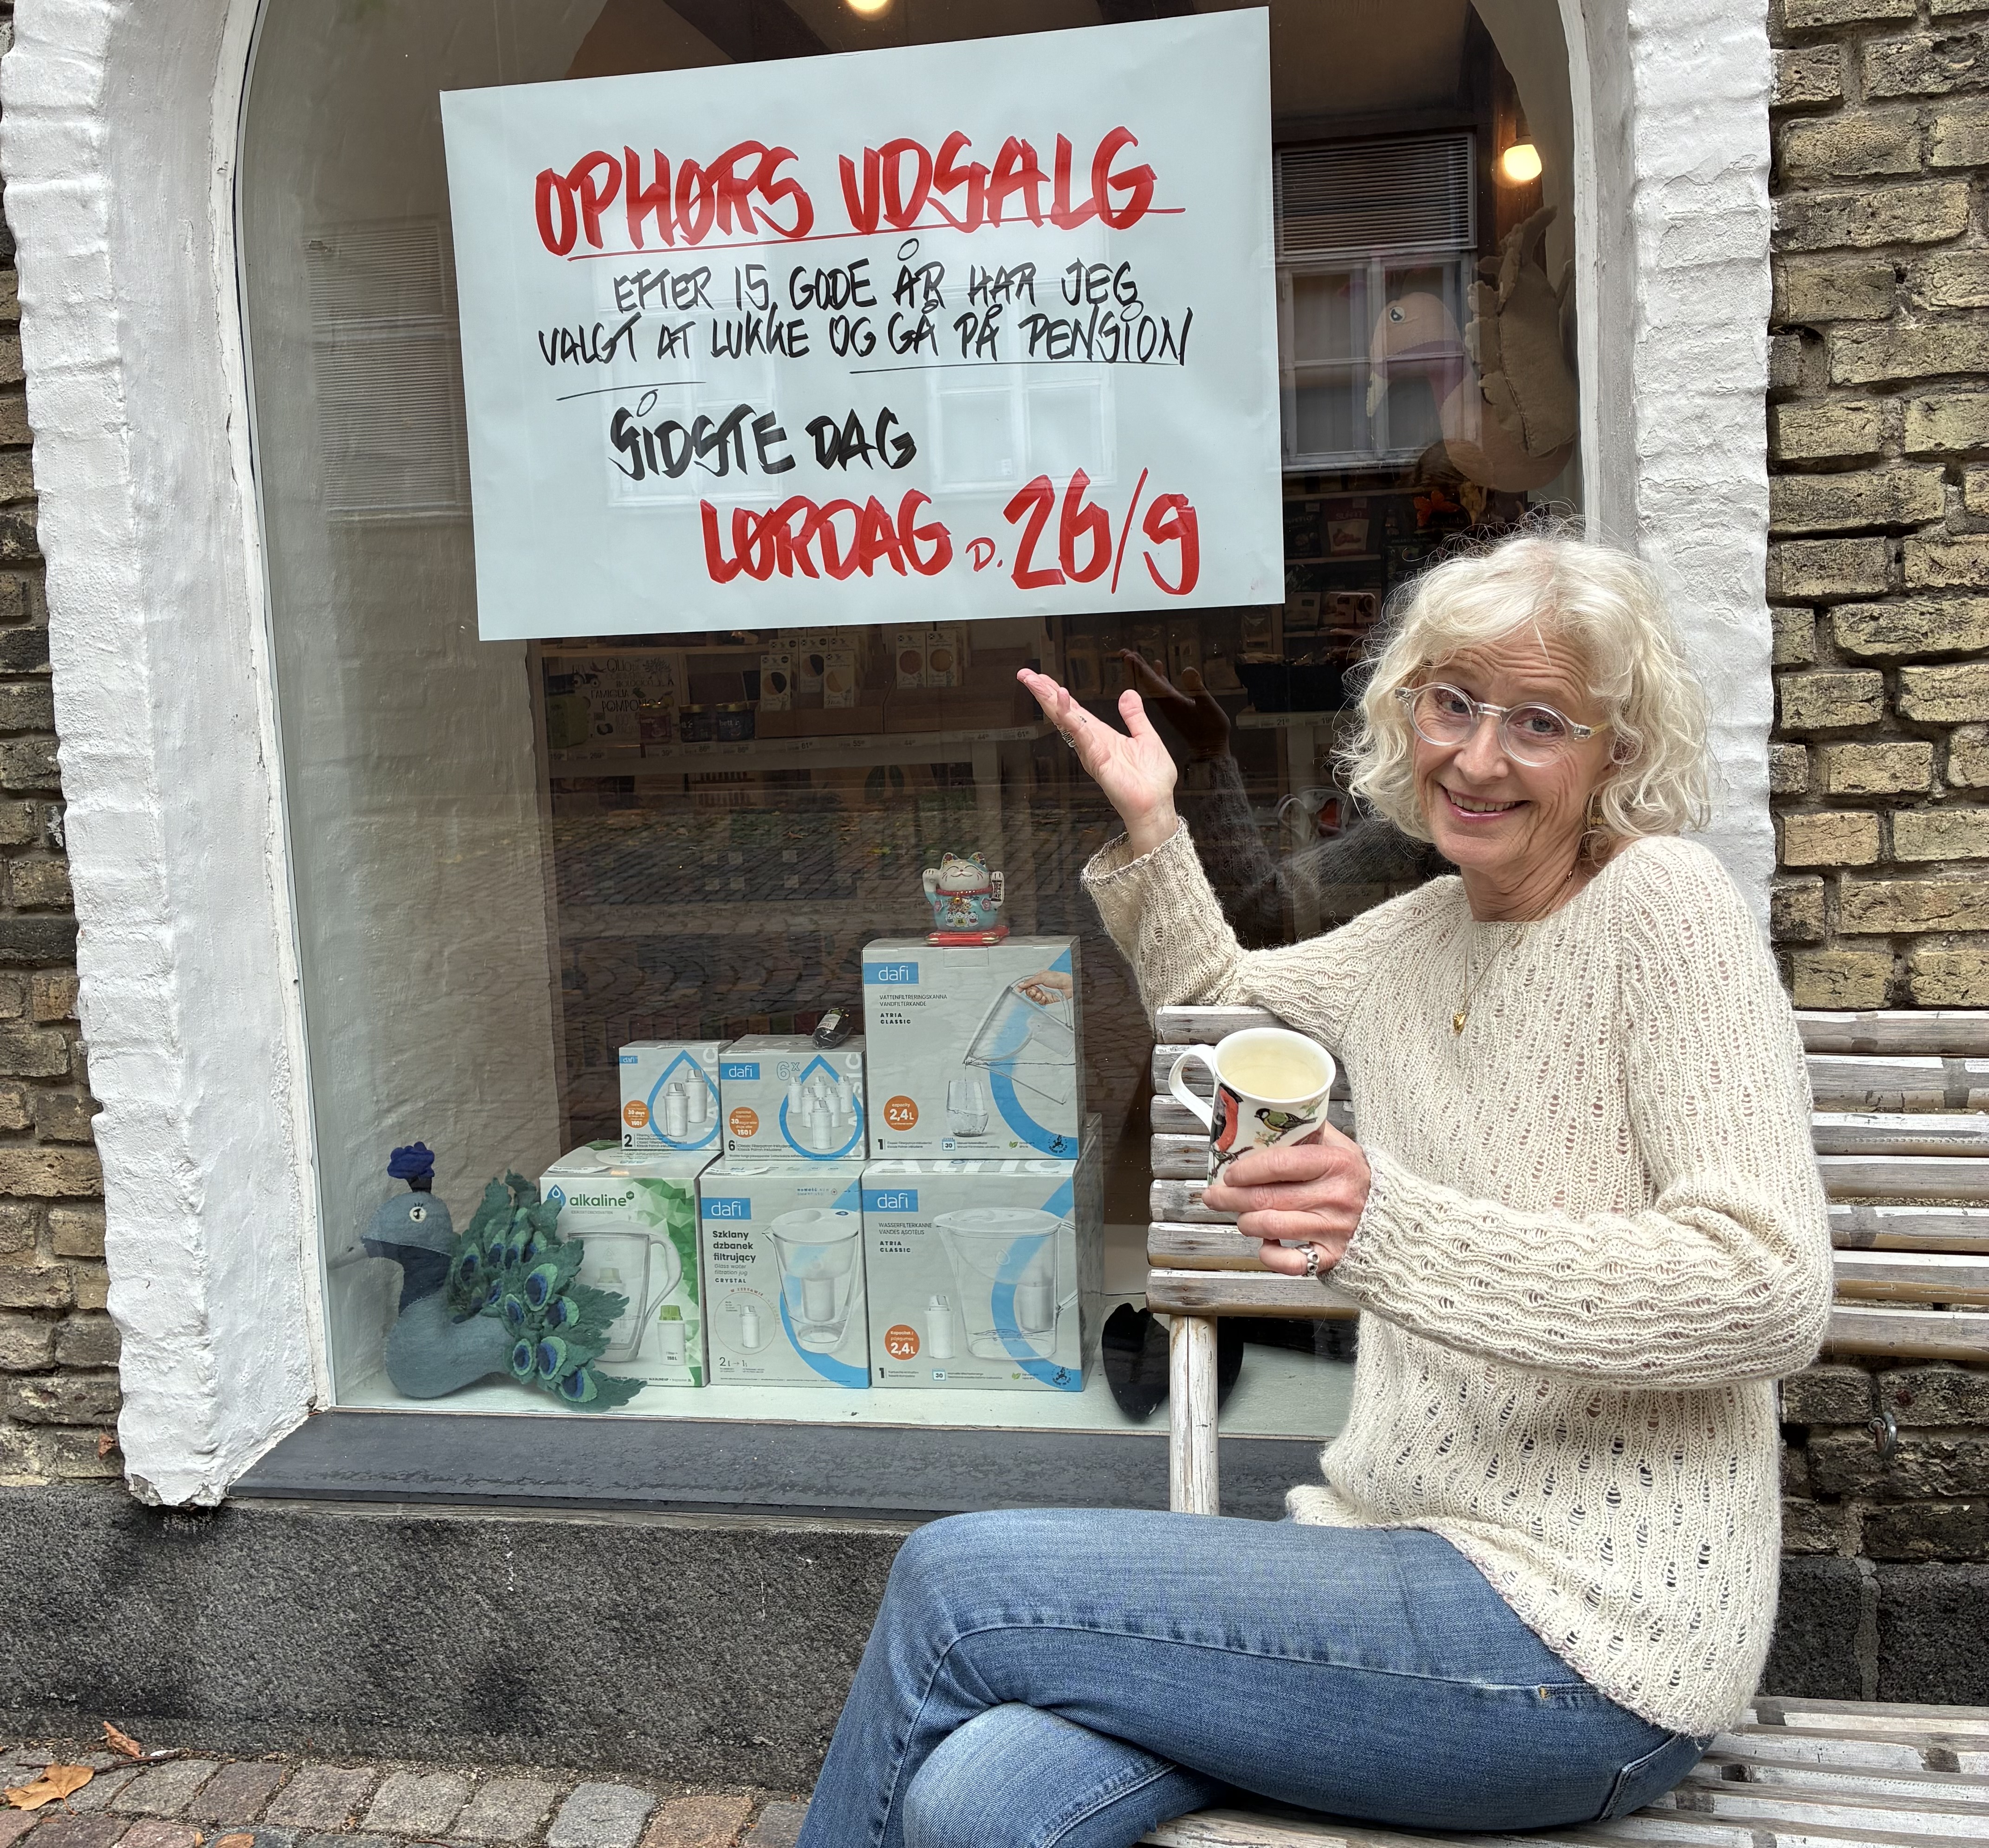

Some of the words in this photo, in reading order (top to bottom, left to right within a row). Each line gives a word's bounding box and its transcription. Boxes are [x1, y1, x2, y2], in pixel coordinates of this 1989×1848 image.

[536, 141, 813, 256] OPHØRS
[838, 126, 1156, 234] UDSALG
[614, 266, 714, 313] EFTER
[789, 258, 878, 310] GODE
[891, 238, 946, 309] ÅR
[967, 262, 1036, 307] HAR
[1061, 258, 1143, 305] JEG
[539, 312, 642, 366] VALGT
[657, 321, 696, 359] AT
[711, 302, 810, 359] LUKKE
[829, 315, 877, 357] OG
[888, 299, 939, 357] GÅ
[953, 304, 1003, 362] PÅ
[1018, 302, 1193, 366] PENSION
[609, 389, 796, 481] SIDSTE
[805, 407, 917, 472] DAG
[700, 487, 952, 584] LØRDAG
[966, 538, 1003, 573] D.
[1003, 467, 1200, 596] 26/9
[878, 966, 909, 981] dafi
[729, 1066, 752, 1077] dafi
[624, 1134, 632, 1147] 2
[728, 1140, 735, 1151] 6
[878, 1139, 883, 1150] 1
[570, 1194, 627, 1206] alkaline
[877, 1193, 908, 1208] dafi
[711, 1200, 741, 1217] dafi
[713, 1231, 749, 1240] Szklany
[714, 1252, 756, 1263] filtrujący
[719, 1357, 726, 1366] 2
[879, 1368, 884, 1378] 1
